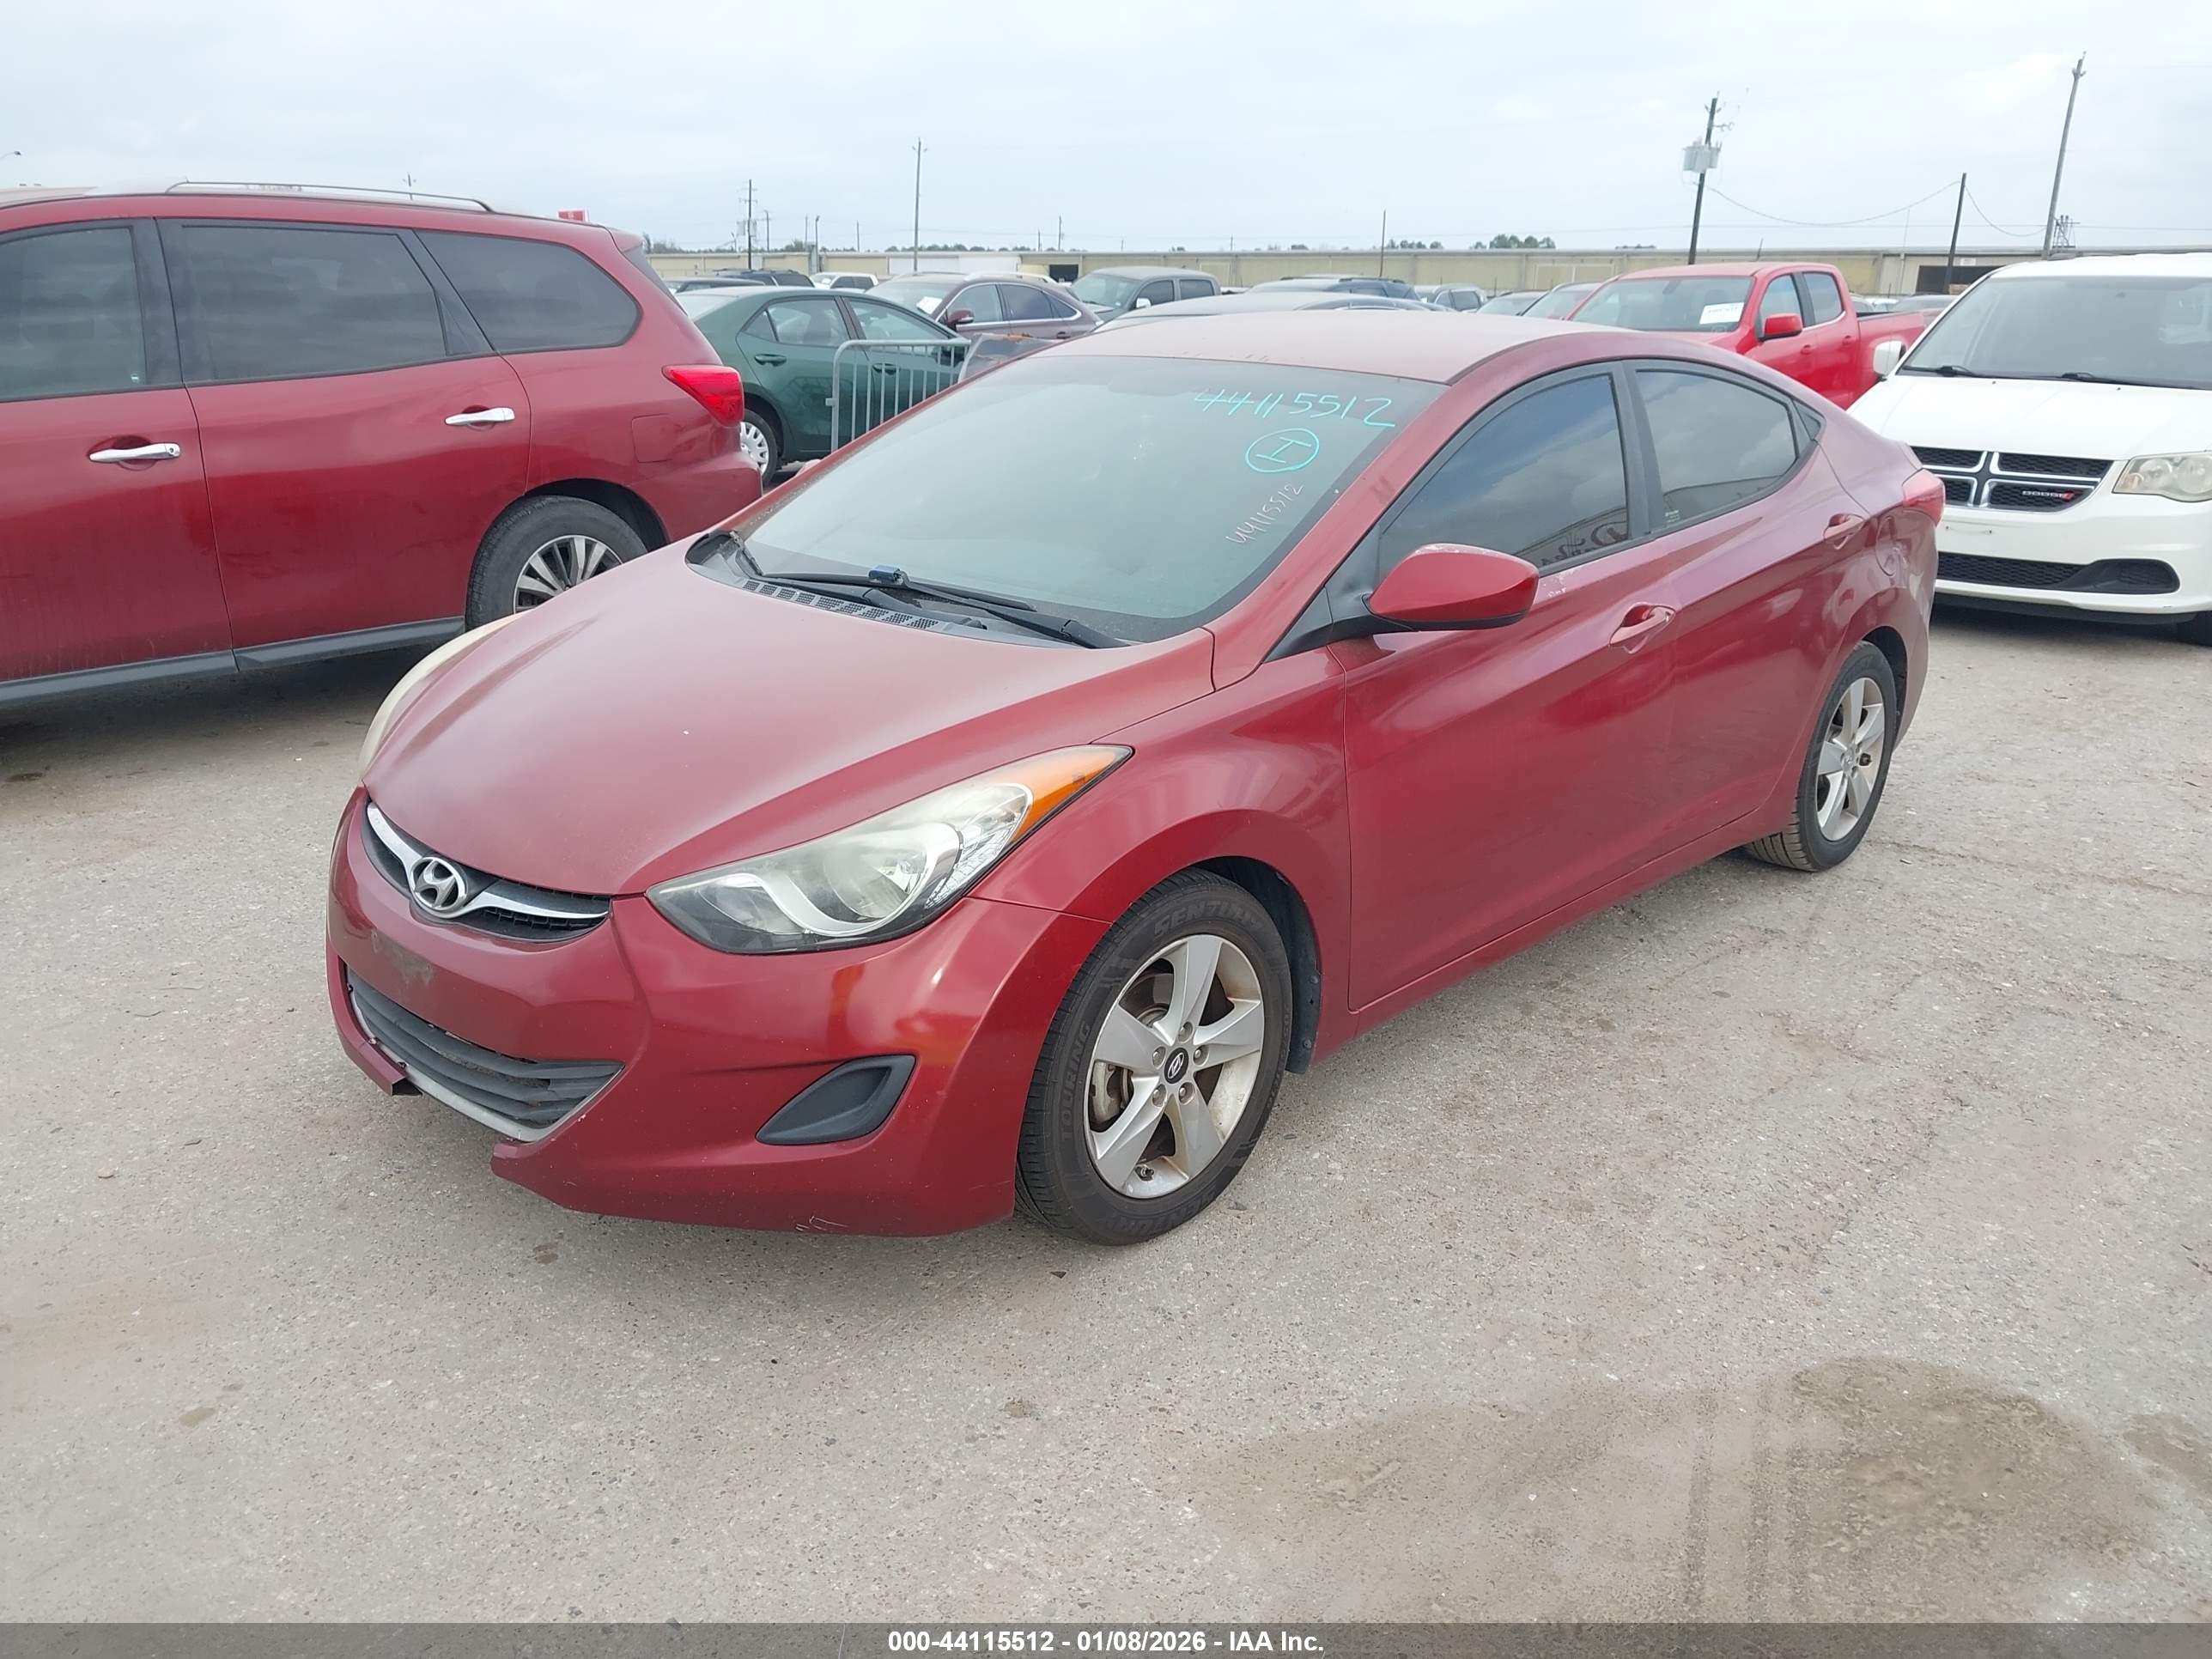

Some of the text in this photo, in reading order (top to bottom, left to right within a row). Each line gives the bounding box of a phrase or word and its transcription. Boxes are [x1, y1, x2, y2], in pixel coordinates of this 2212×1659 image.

[1194, 389, 1395, 427] 44115512
[1225, 483, 1304, 544] 44115512
[1060, 1020, 1091, 1142] TOURING
